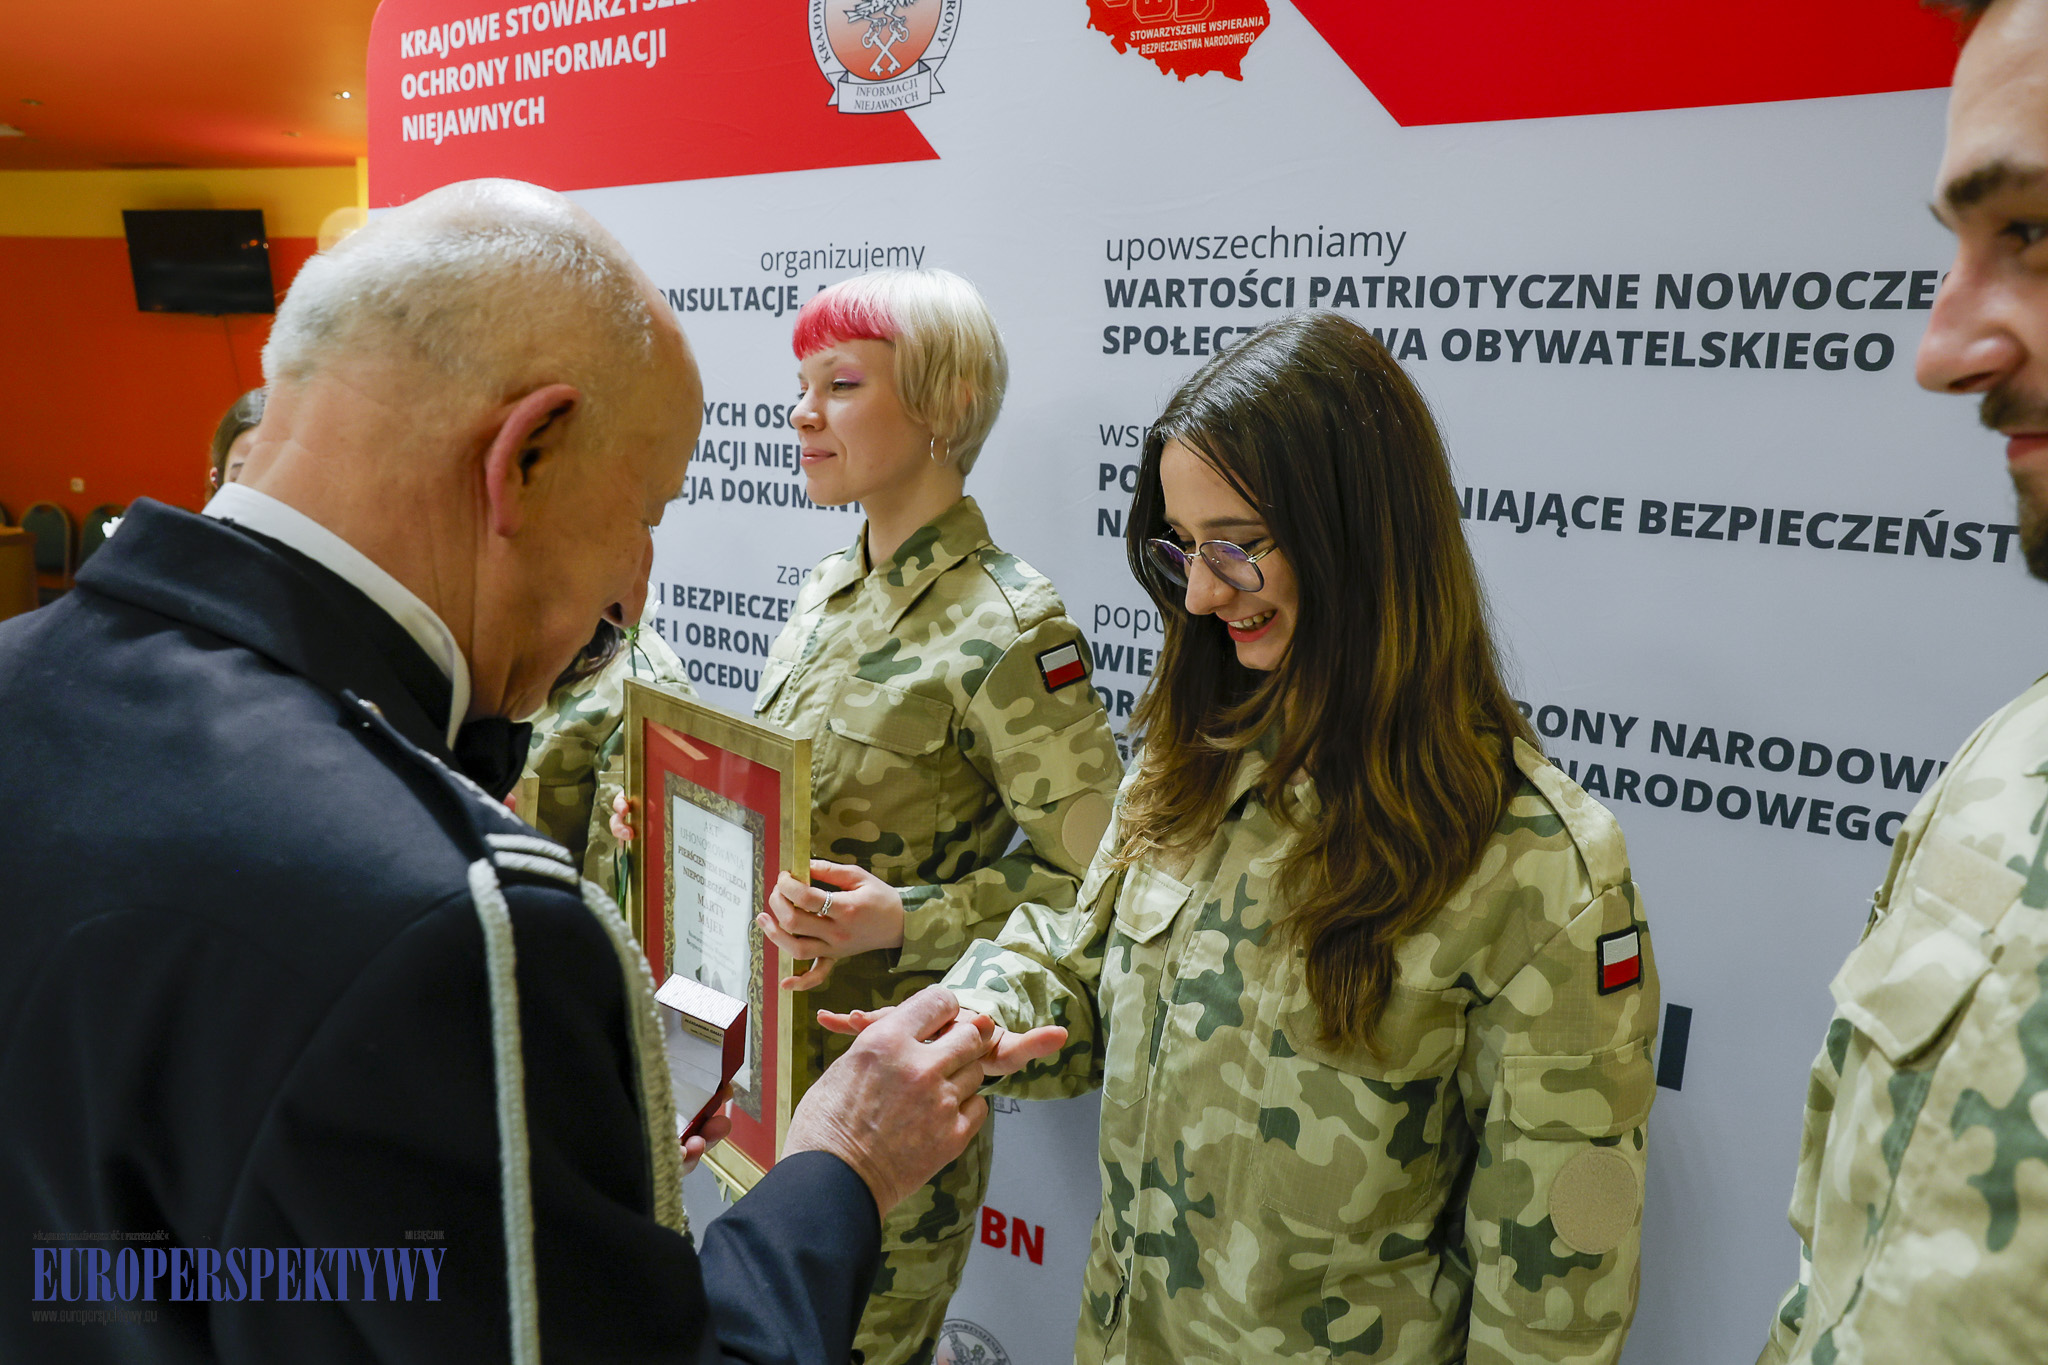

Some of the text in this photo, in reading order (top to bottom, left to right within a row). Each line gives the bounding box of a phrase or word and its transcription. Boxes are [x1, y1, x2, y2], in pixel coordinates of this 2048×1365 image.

[400, 0, 697, 59] KRAJOWE STOWARZ
[1130, 16, 1265, 41] STOWARZYSZENIE WSPIERANIA
[1203, 32, 1255, 48] NARODOWEGO
[400, 28, 667, 100] OCHRONY INFORMACJI
[854, 91, 919, 111] NIEJAWNYCH
[856, 78, 918, 97] INFORMACJI
[402, 96, 545, 146] NIEJAWNYCH
[760, 241, 926, 278] organizujemy
[1106, 225, 1407, 270] upowszechniamy
[1104, 269, 1951, 310] WARTOŚCI PATRIOTYCZNE NOWOCZE
[1441, 327, 1895, 372] OBYWATELSKIEGO
[673, 584, 796, 623] BEZPIECZE
[673, 620, 678, 643] I
[679, 656, 764, 693] OCEDU
[1092, 641, 1162, 677] WIE
